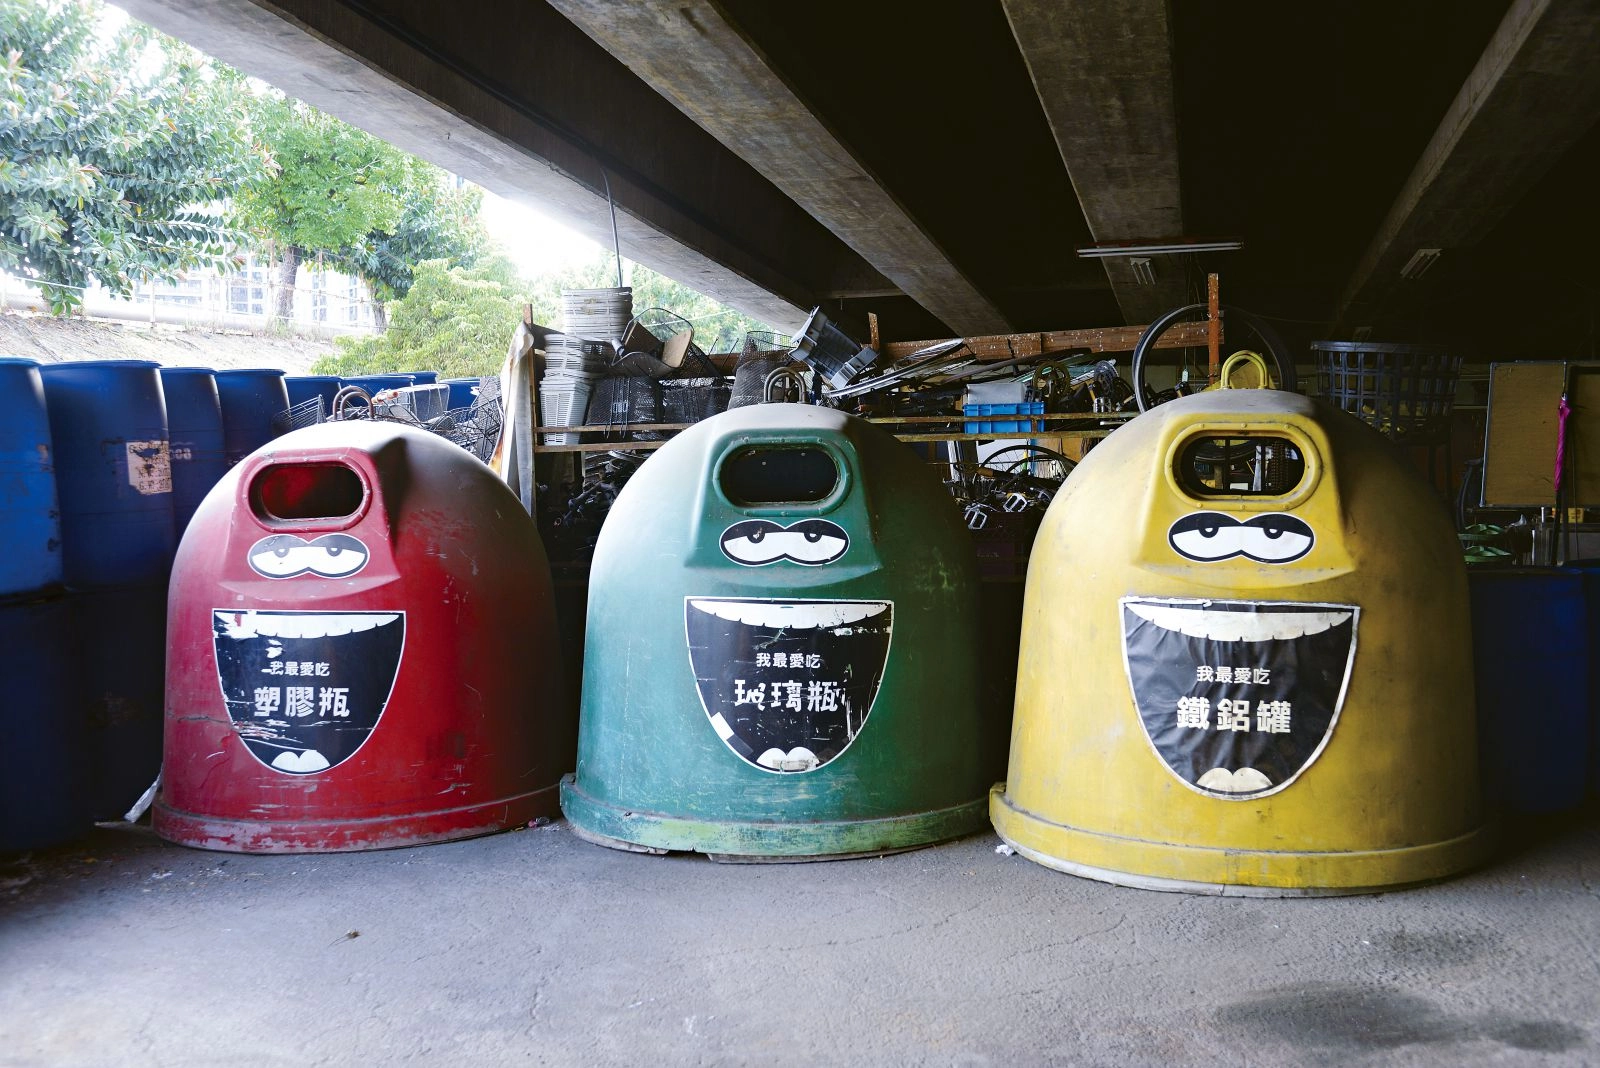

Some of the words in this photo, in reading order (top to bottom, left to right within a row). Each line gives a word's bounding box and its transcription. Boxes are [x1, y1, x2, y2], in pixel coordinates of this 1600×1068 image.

[756, 652, 821, 669] 我最愛吃
[1196, 665, 1271, 685] 我最愛吃
[253, 686, 350, 717] 塑膠瓶
[1176, 695, 1291, 734] 鐵鋁罐
